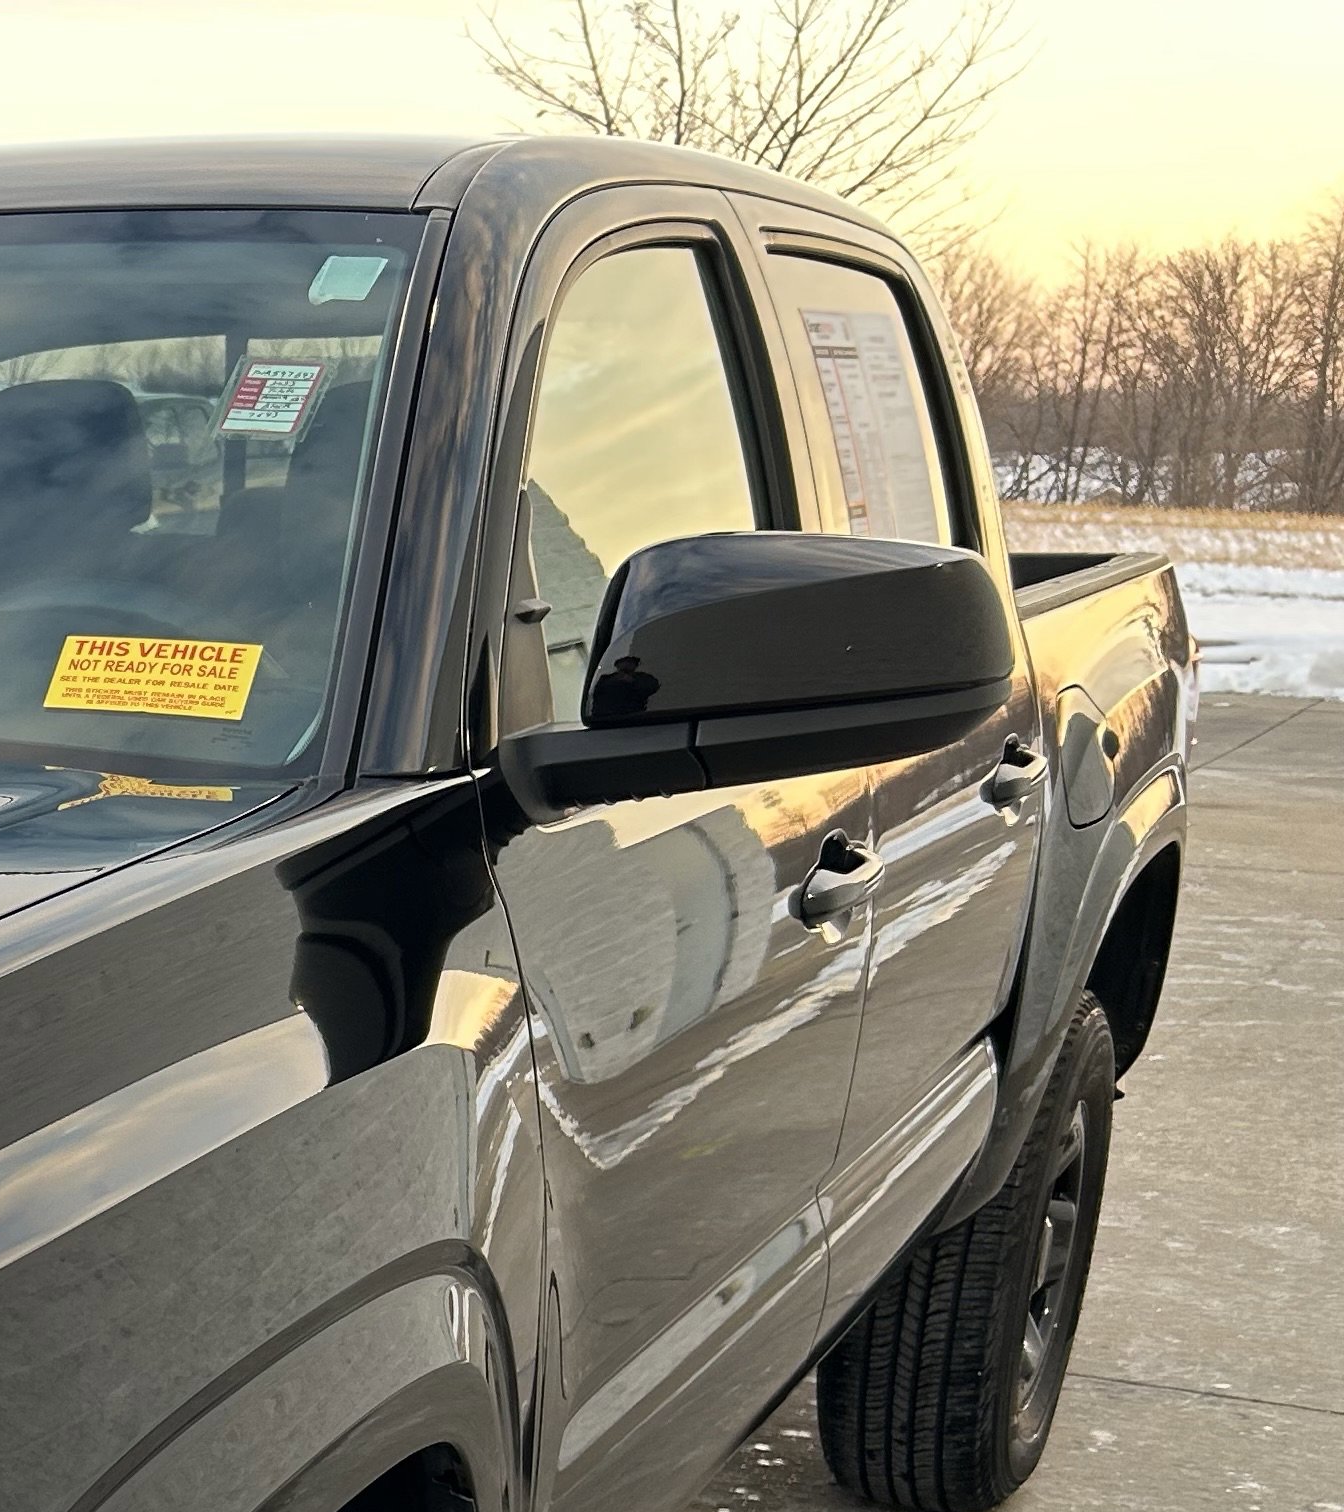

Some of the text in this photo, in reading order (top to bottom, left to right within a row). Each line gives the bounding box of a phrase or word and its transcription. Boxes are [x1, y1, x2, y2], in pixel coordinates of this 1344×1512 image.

[75, 640, 248, 664] THIS VEHICLE
[68, 658, 240, 680] NOT READY FOR SALE
[103, 677, 142, 686] DEALER
[145, 679, 166, 687] FOR
[170, 681, 210, 689] RESALE
[213, 683, 240, 692] DATE
